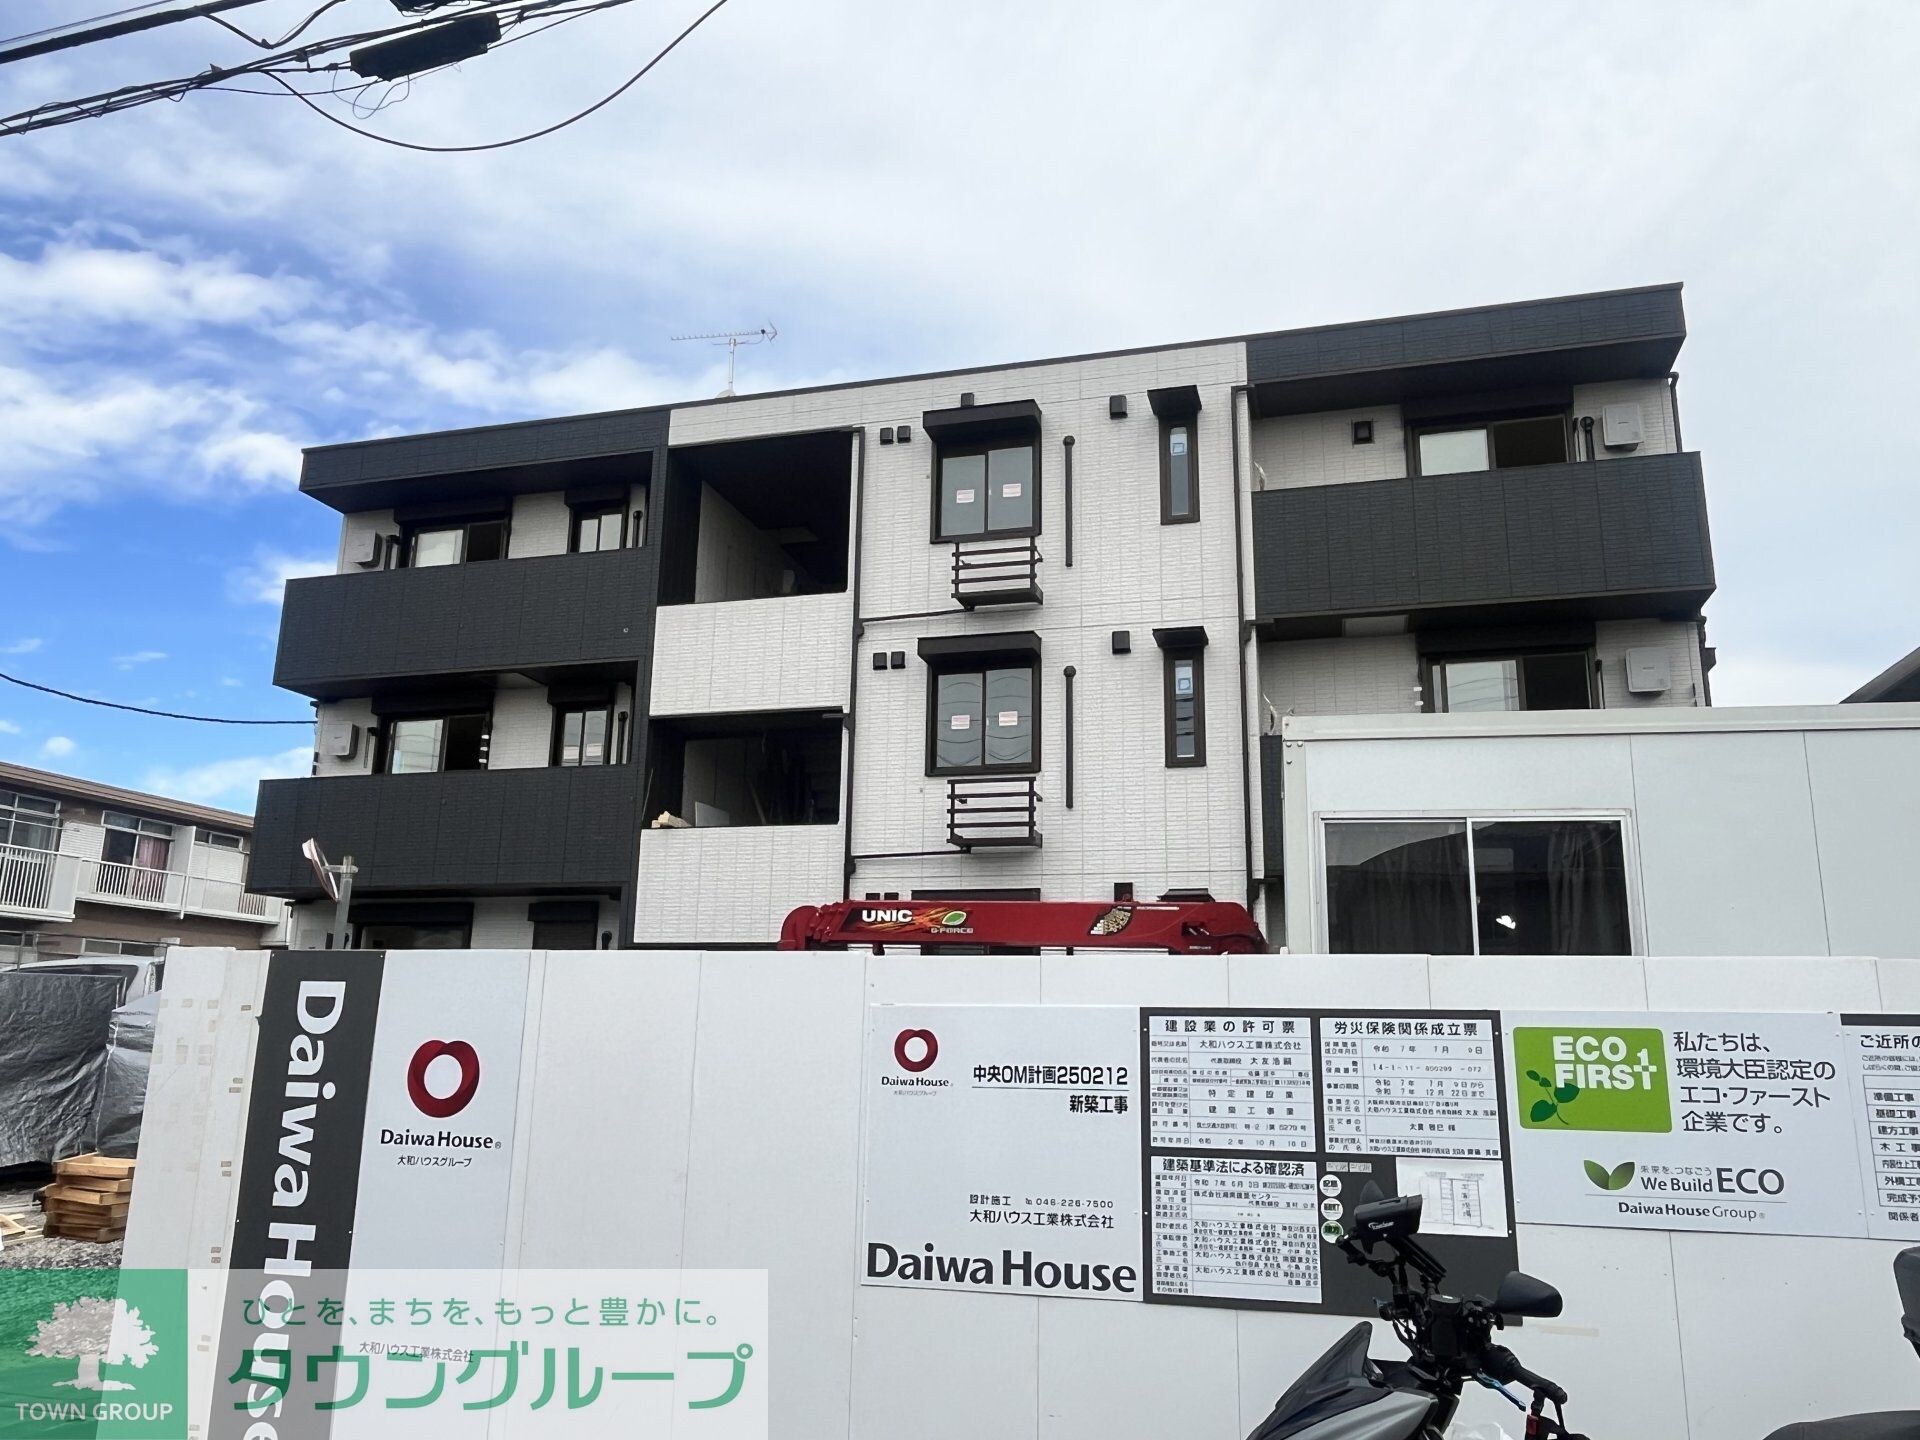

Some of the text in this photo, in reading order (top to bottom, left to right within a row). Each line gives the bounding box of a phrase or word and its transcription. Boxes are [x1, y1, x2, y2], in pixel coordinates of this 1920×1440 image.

[862, 910, 913, 922] UNIC
[1166, 1019, 1295, 1033] 建設業の許可票
[1335, 1021, 1478, 1036] 労災保険関係成立票
[1200, 1040, 1301, 1050] 大和ハウス工業株式会社
[1553, 1035, 1627, 1061] ECO
[1673, 1031, 1771, 1053] 私たちは、
[1860, 1034, 1920, 1049] ご近所の
[973, 1065, 1128, 1085] 中央OM計画250212
[1676, 1058, 1835, 1080] 環境大臣認定の
[881, 1076, 914, 1086] Daiwa
[272, 981, 346, 1207] Daiwa
[1874, 1092, 1914, 1102] 準備工事
[1069, 1095, 1128, 1114] 新築工事
[1876, 1109, 1916, 1119] 基礎工事
[1682, 1111, 1782, 1133] 企業です。
[381, 1129, 435, 1146] Daiwa
[1878, 1126, 1919, 1136] 建方工事
[398, 1155, 472, 1167] 大和ハウスグループ
[1163, 1159, 1304, 1176] 建築基準法による確認済
[1641, 1167, 1785, 1195] We Build ECO
[970, 1194, 1011, 1206] 設計施工
[1887, 1193, 1920, 1203] 完成予
[1618, 1201, 1663, 1215] Daiwa
[1665, 1203, 1710, 1217] House
[969, 1210, 1114, 1229] 大和ハウス工業株式会社
[1194, 1221, 1276, 1231] 大和ハウス工業株式会社
[1194, 1236, 1277, 1246] 大和ハウス工業株式会社
[1195, 1251, 1278, 1262] 大和ハウス工業株式会社
[867, 1242, 1136, 1292] Daiwa House
[1196, 1267, 1279, 1277] 大和ハウス工業株式会社
[360, 1341, 475, 1363] 大和ハウス工業株式会社
